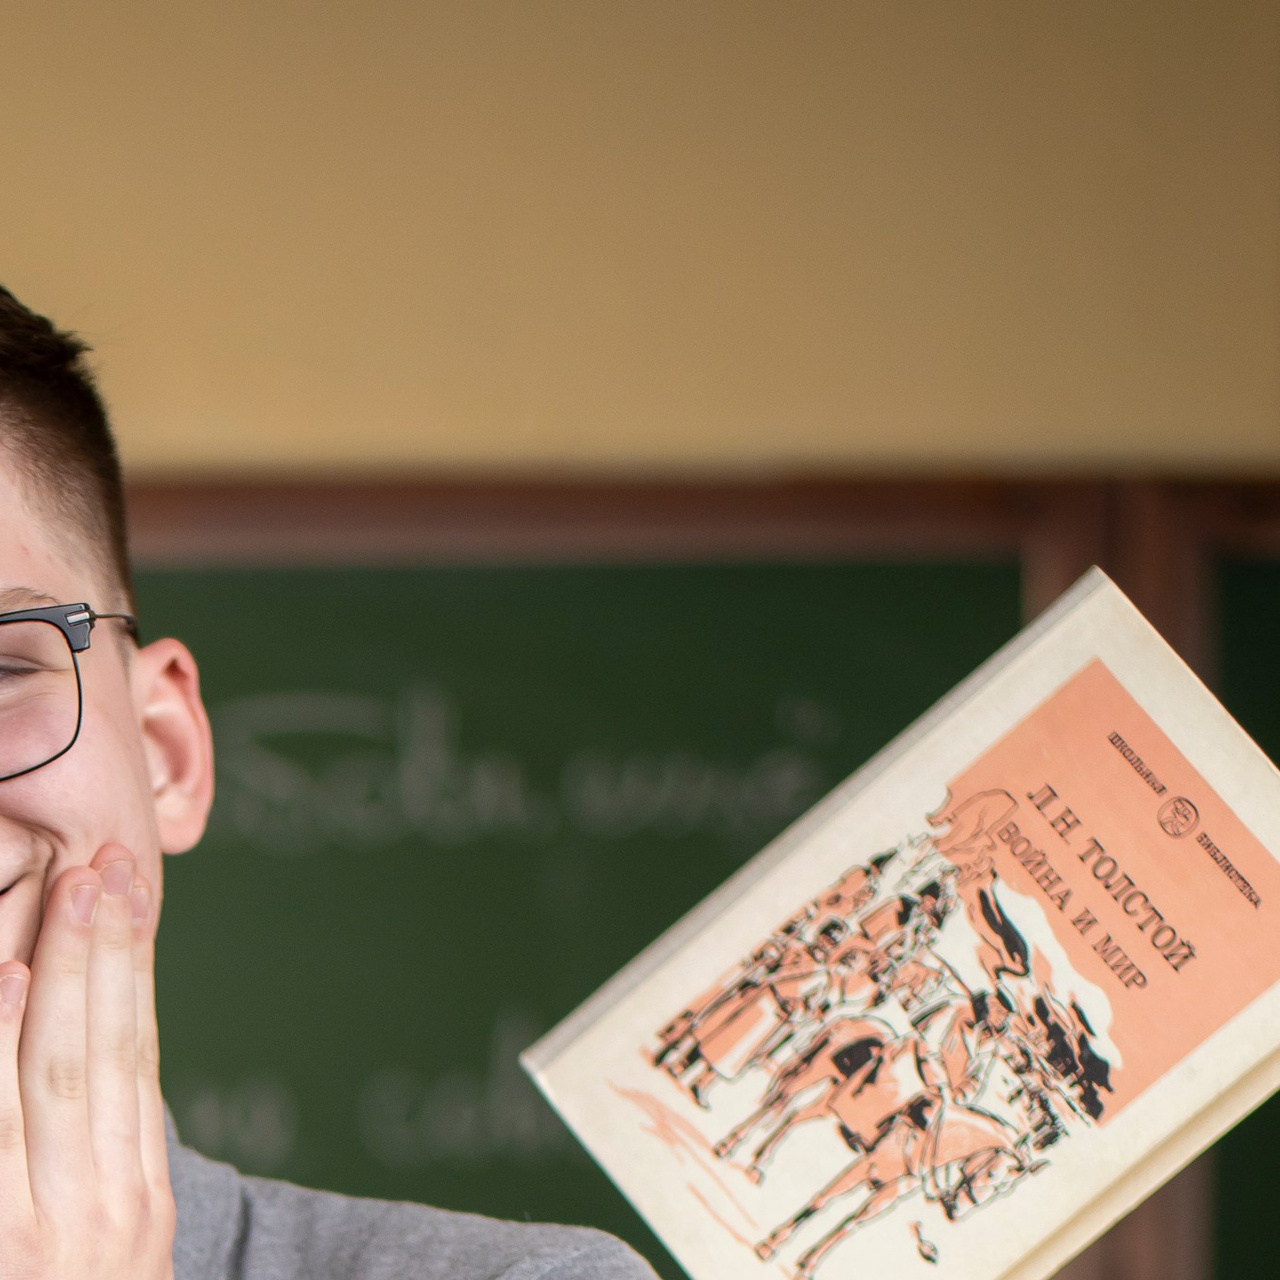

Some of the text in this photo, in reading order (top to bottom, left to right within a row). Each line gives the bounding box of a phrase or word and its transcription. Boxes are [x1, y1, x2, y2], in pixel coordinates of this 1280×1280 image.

[1077, 836, 1197, 973] ТОЛСТОЙ
[1107, 730, 1263, 909] ШКОЛЬНАЯ БИБЛИОТЕКА
[997, 820, 1149, 990] ВОЙНА И МИР
